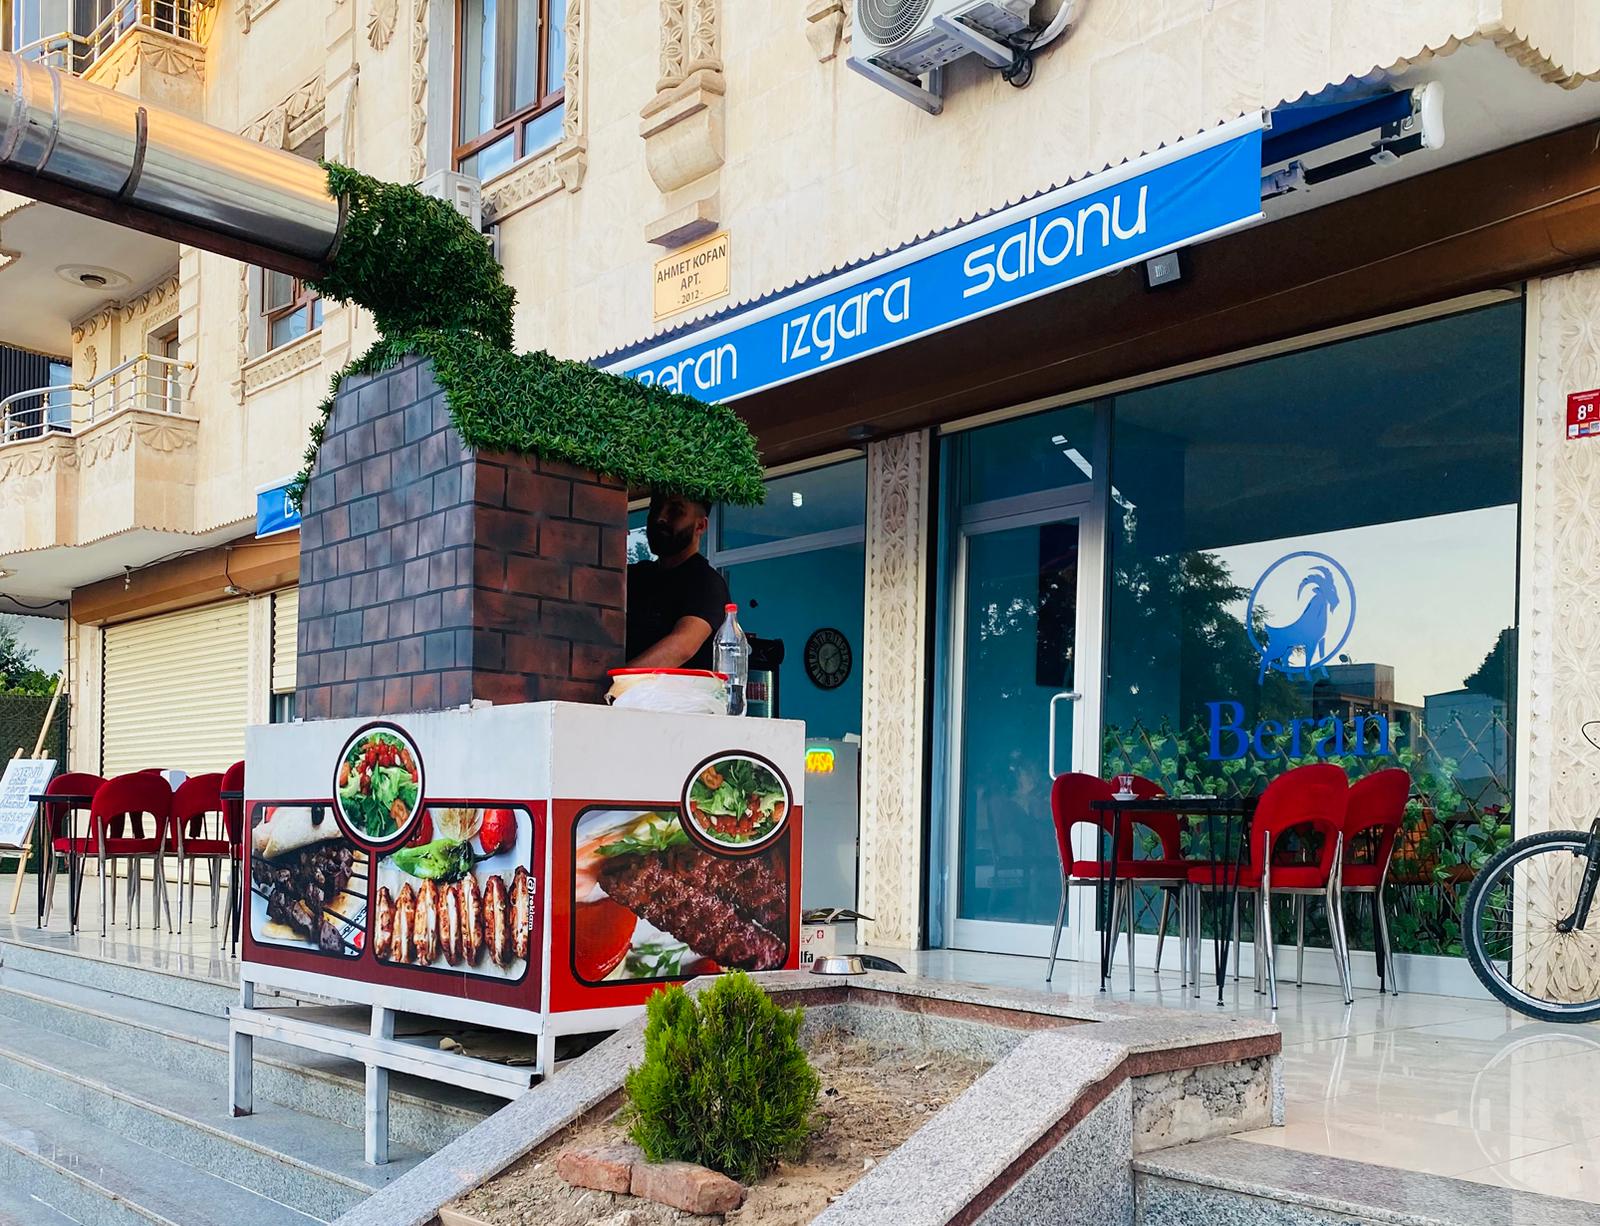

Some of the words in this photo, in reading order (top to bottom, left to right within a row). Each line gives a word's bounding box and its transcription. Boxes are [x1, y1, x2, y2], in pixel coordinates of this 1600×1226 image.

[962, 184, 1149, 299] salonu
[657, 258, 691, 284] AHMET
[692, 244, 726, 269] KOFAN
[680, 272, 702, 291] APT.
[1204, 700, 1392, 761] Beran
[806, 752, 834, 773] KASA
